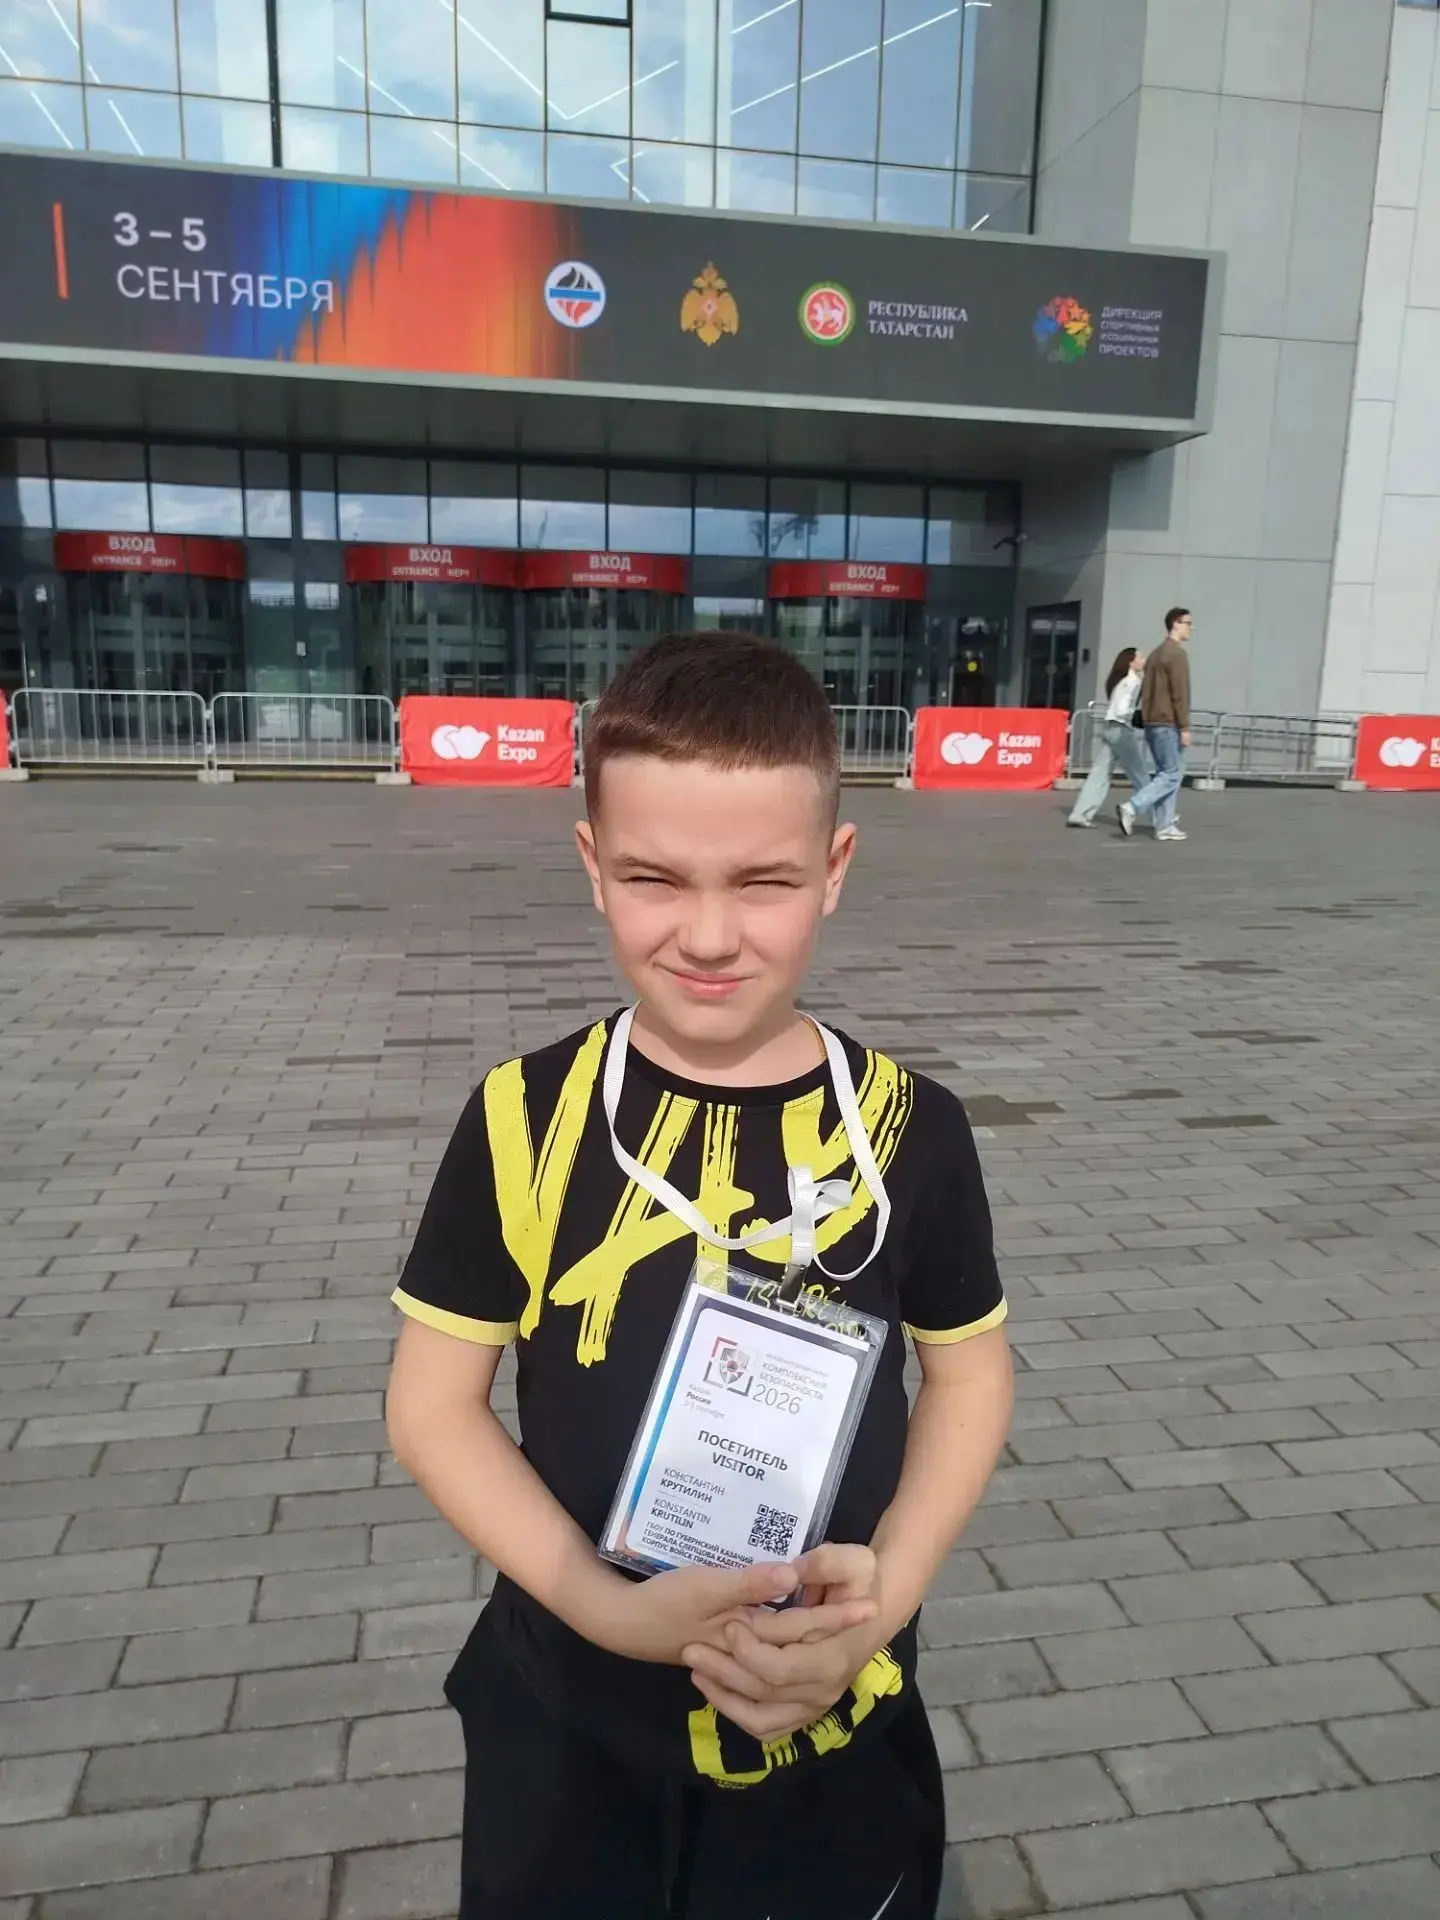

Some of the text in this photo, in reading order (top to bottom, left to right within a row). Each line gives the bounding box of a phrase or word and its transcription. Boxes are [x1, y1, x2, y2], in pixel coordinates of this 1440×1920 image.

[113, 212, 140, 246] 3
[182, 217, 208, 251] 5
[117, 264, 335, 313] СЕНТЯБРЯ
[868, 300, 968, 322] РЕСПУБЛИКА
[868, 320, 955, 340] ТАТАРСТАН
[108, 535, 156, 554] ВХОД
[409, 547, 452, 565] ВХОД
[589, 554, 632, 572] ВХОД
[847, 564, 888, 581] ВХОД
[497, 724, 545, 743] Kazan
[998, 732, 1042, 748] Kazan
[497, 742, 538, 764] Expo
[997, 749, 1033, 768] Expo
[751, 1382, 803, 1415] 2026
[697, 1430, 789, 1471] ПОСЕТИТЕЛЬ
[710, 1452, 766, 1480] VISITOR
[660, 1478, 712, 1502] КРУТИЛИН
[663, 1467, 725, 1495] КОНСТАНТИН
[650, 1507, 693, 1528] KRUTILIN
[653, 1497, 711, 1524] KONSTANTIN
[641, 1536, 668, 1550] КОРПУС
[669, 1546, 693, 1559] ВОЙСК
[644, 1528, 678, 1545] ГЕНЕРАЛА
[678, 1541, 715, 1559] СЛЕПЦОВА
[664, 1527, 675, 1536] ПО
[676, 1531, 720, 1552] ГУБЕРНСКИЙ
[720, 1548, 753, 1564] КАЗАЧИЙ
